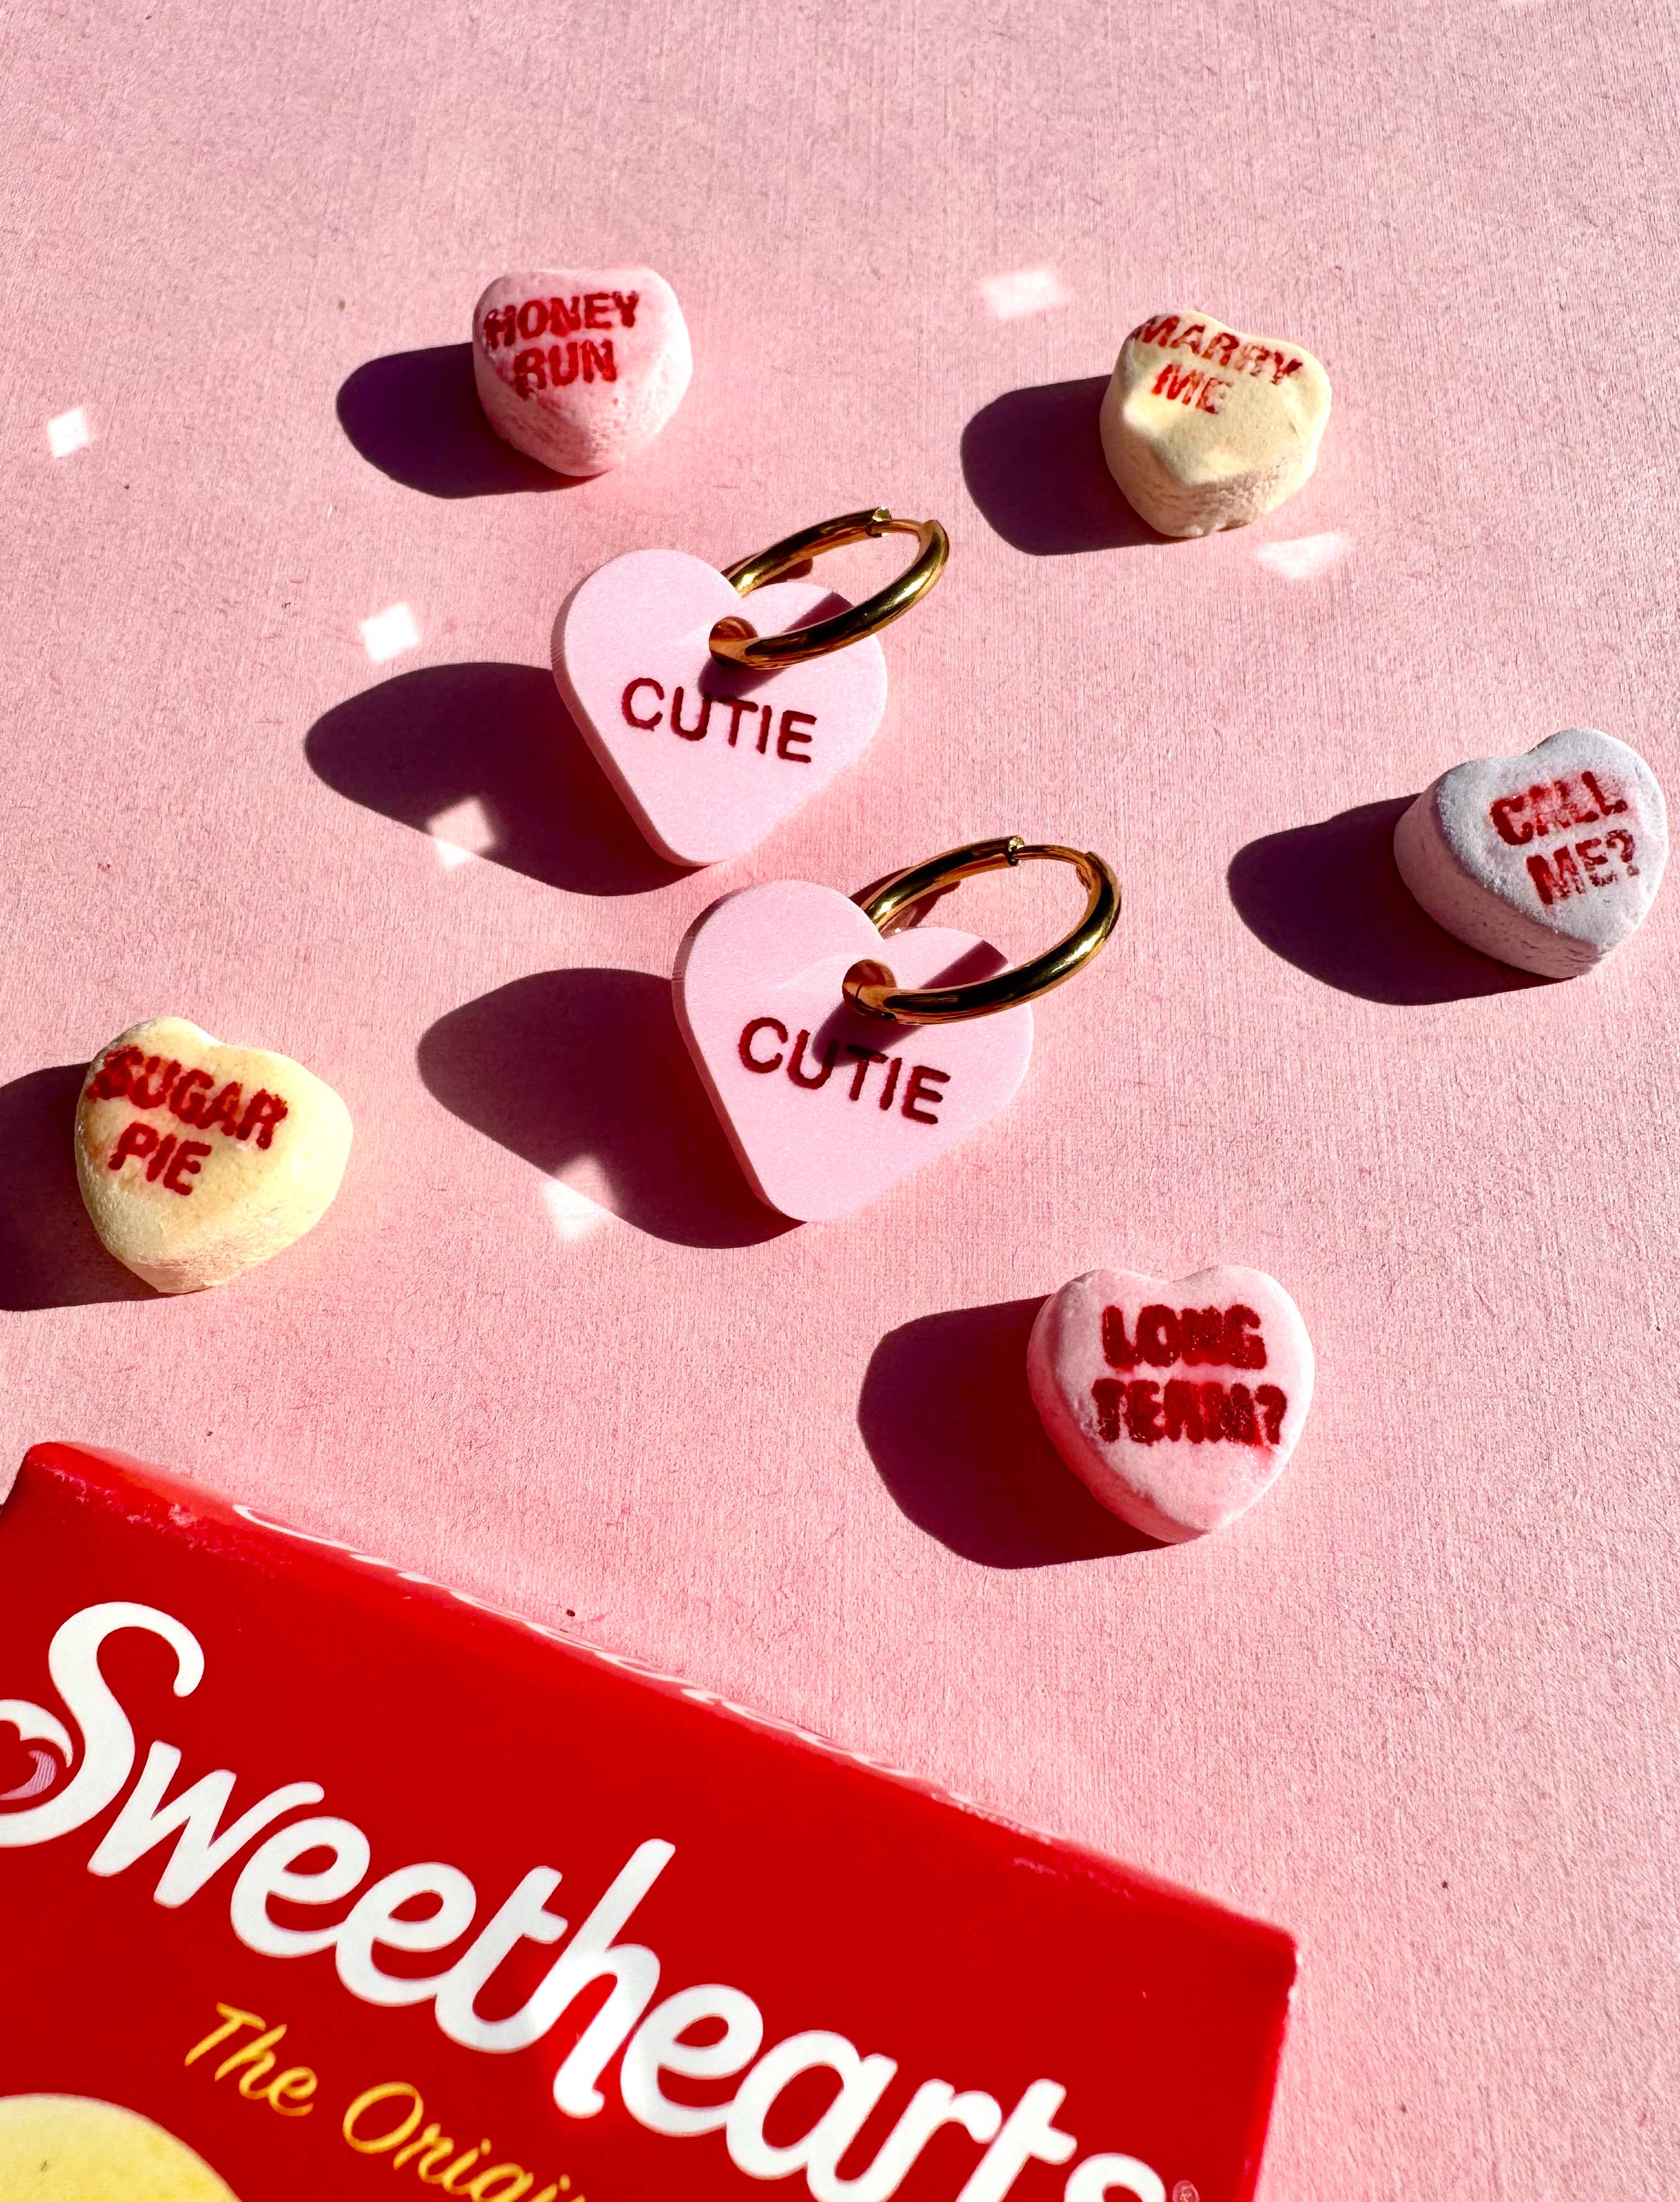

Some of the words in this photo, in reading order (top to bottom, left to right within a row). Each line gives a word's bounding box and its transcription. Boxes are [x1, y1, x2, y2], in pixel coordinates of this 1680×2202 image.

[483, 290, 640, 349] HONEY
[1132, 315, 1302, 385] MARRY
[513, 339, 617, 401] RUN
[1150, 363, 1233, 415] ME
[621, 677, 817, 763] CUTIE
[1490, 771, 1629, 845] CALL
[1526, 828, 1640, 905] ME?
[85, 1045, 288, 1150] SUGAR
[738, 1016, 951, 1125] CUTIE
[108, 1122, 212, 1196] PIE
[1102, 1304, 1267, 1371] LONG
[184, 2002, 318, 2117] The
